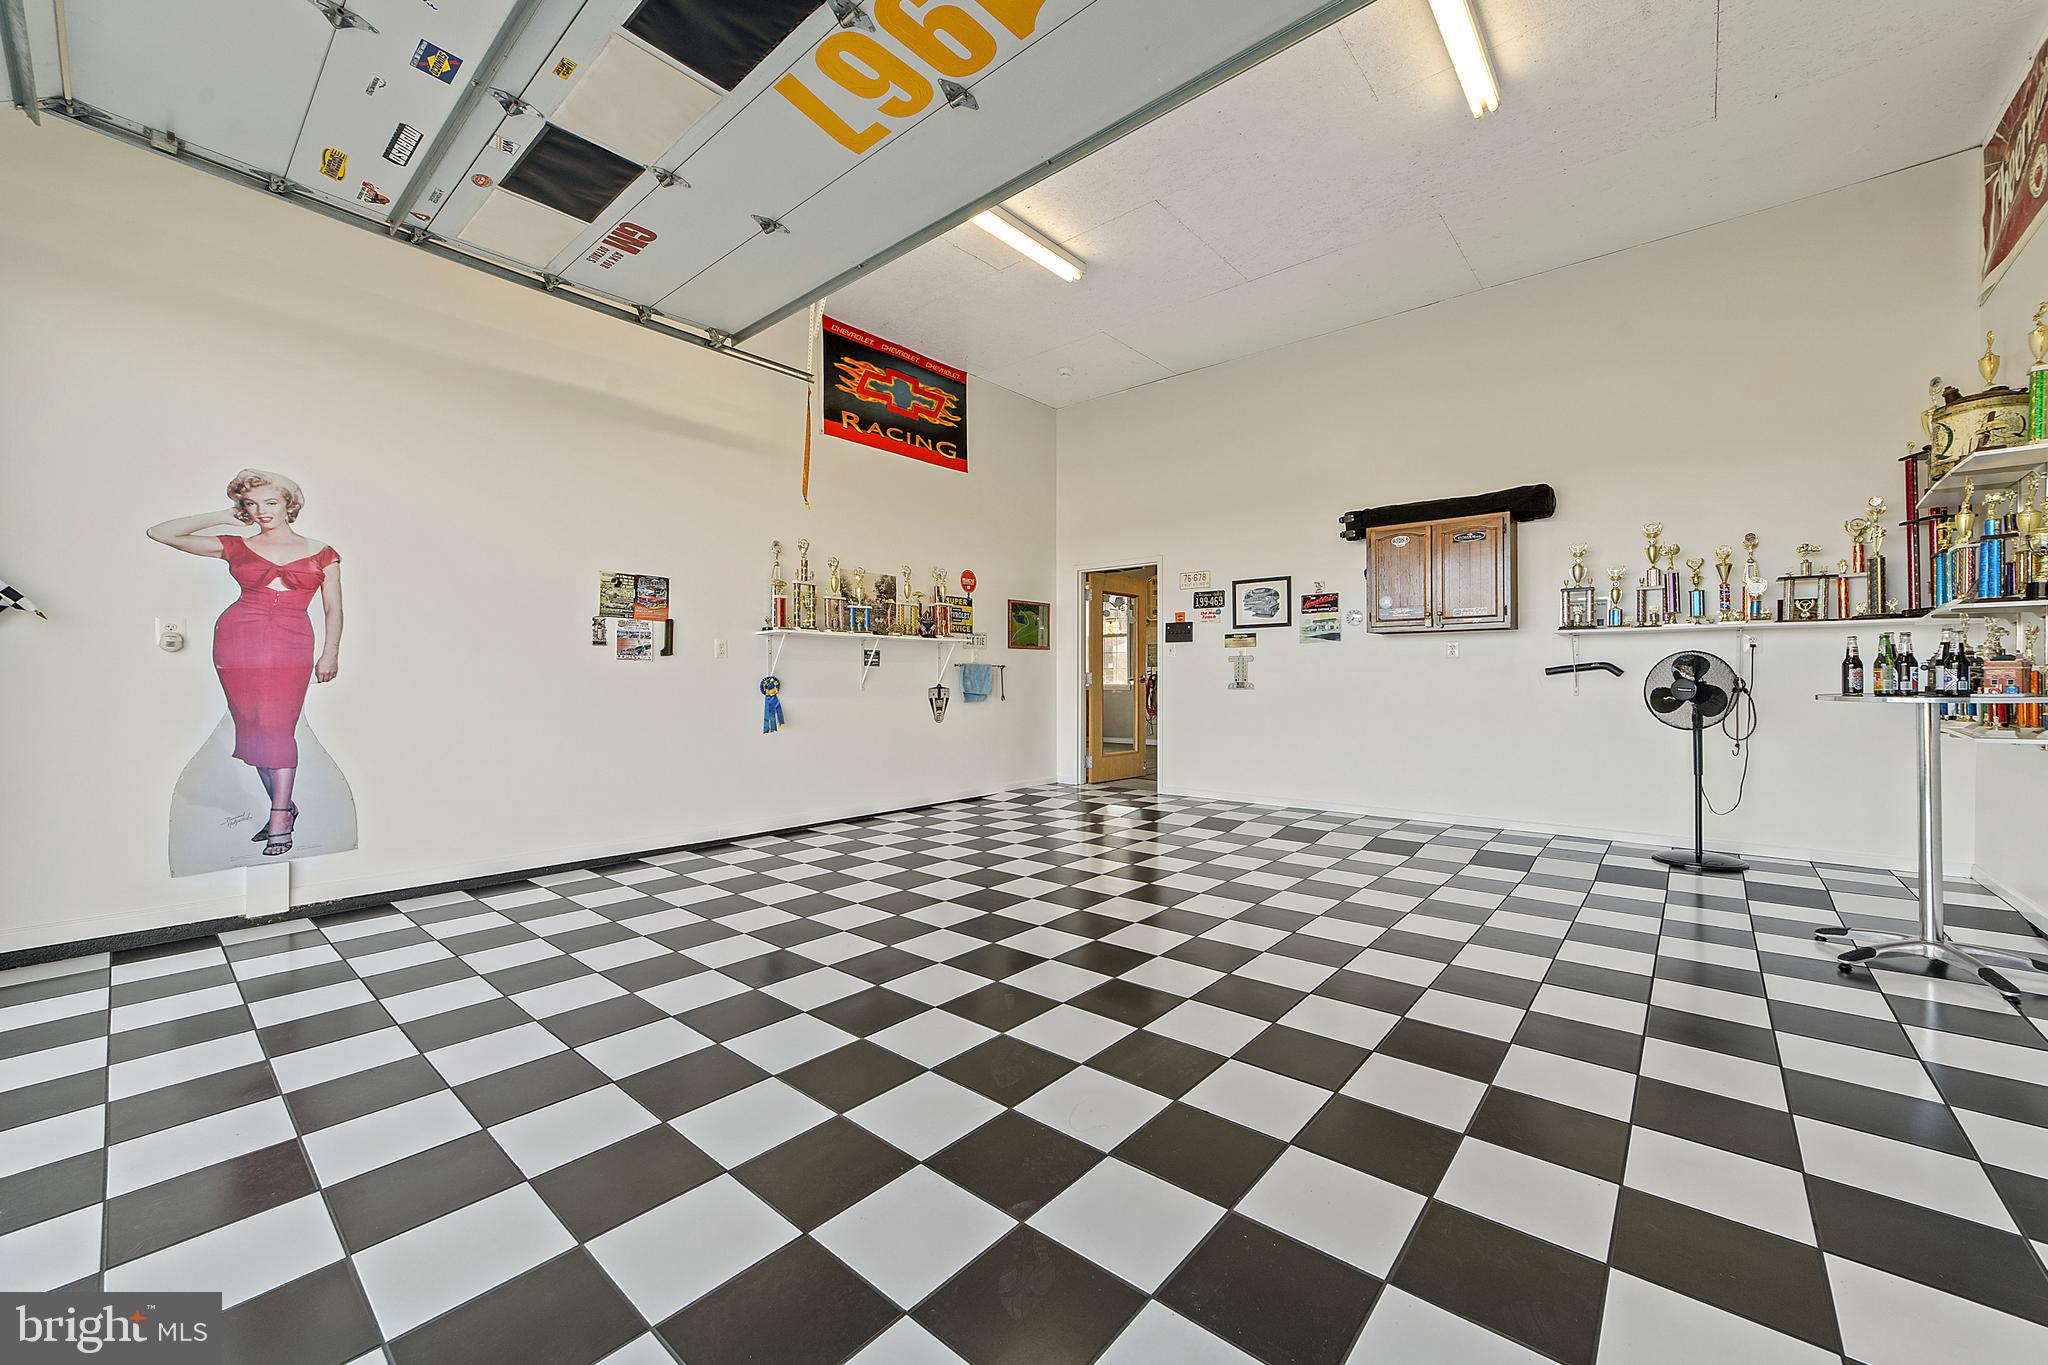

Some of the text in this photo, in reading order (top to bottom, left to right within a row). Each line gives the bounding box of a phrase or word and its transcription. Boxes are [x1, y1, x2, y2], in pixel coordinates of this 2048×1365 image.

[430, 50, 449, 77] SUNOCO
[389, 124, 422, 166] MOROSO
[500, 139, 514, 155] WIX
[602, 222, 658, 255] GM
[586, 245, 610, 264] DETAILS
[600, 251, 624, 269] ASK FOR
[831, 324, 962, 380] CHEVROLET CHEVROLET CHEVROLET
[841, 410, 957, 460] RACING
[945, 597, 968, 605] SUPER
[1195, 596, 1223, 607] 199-469
